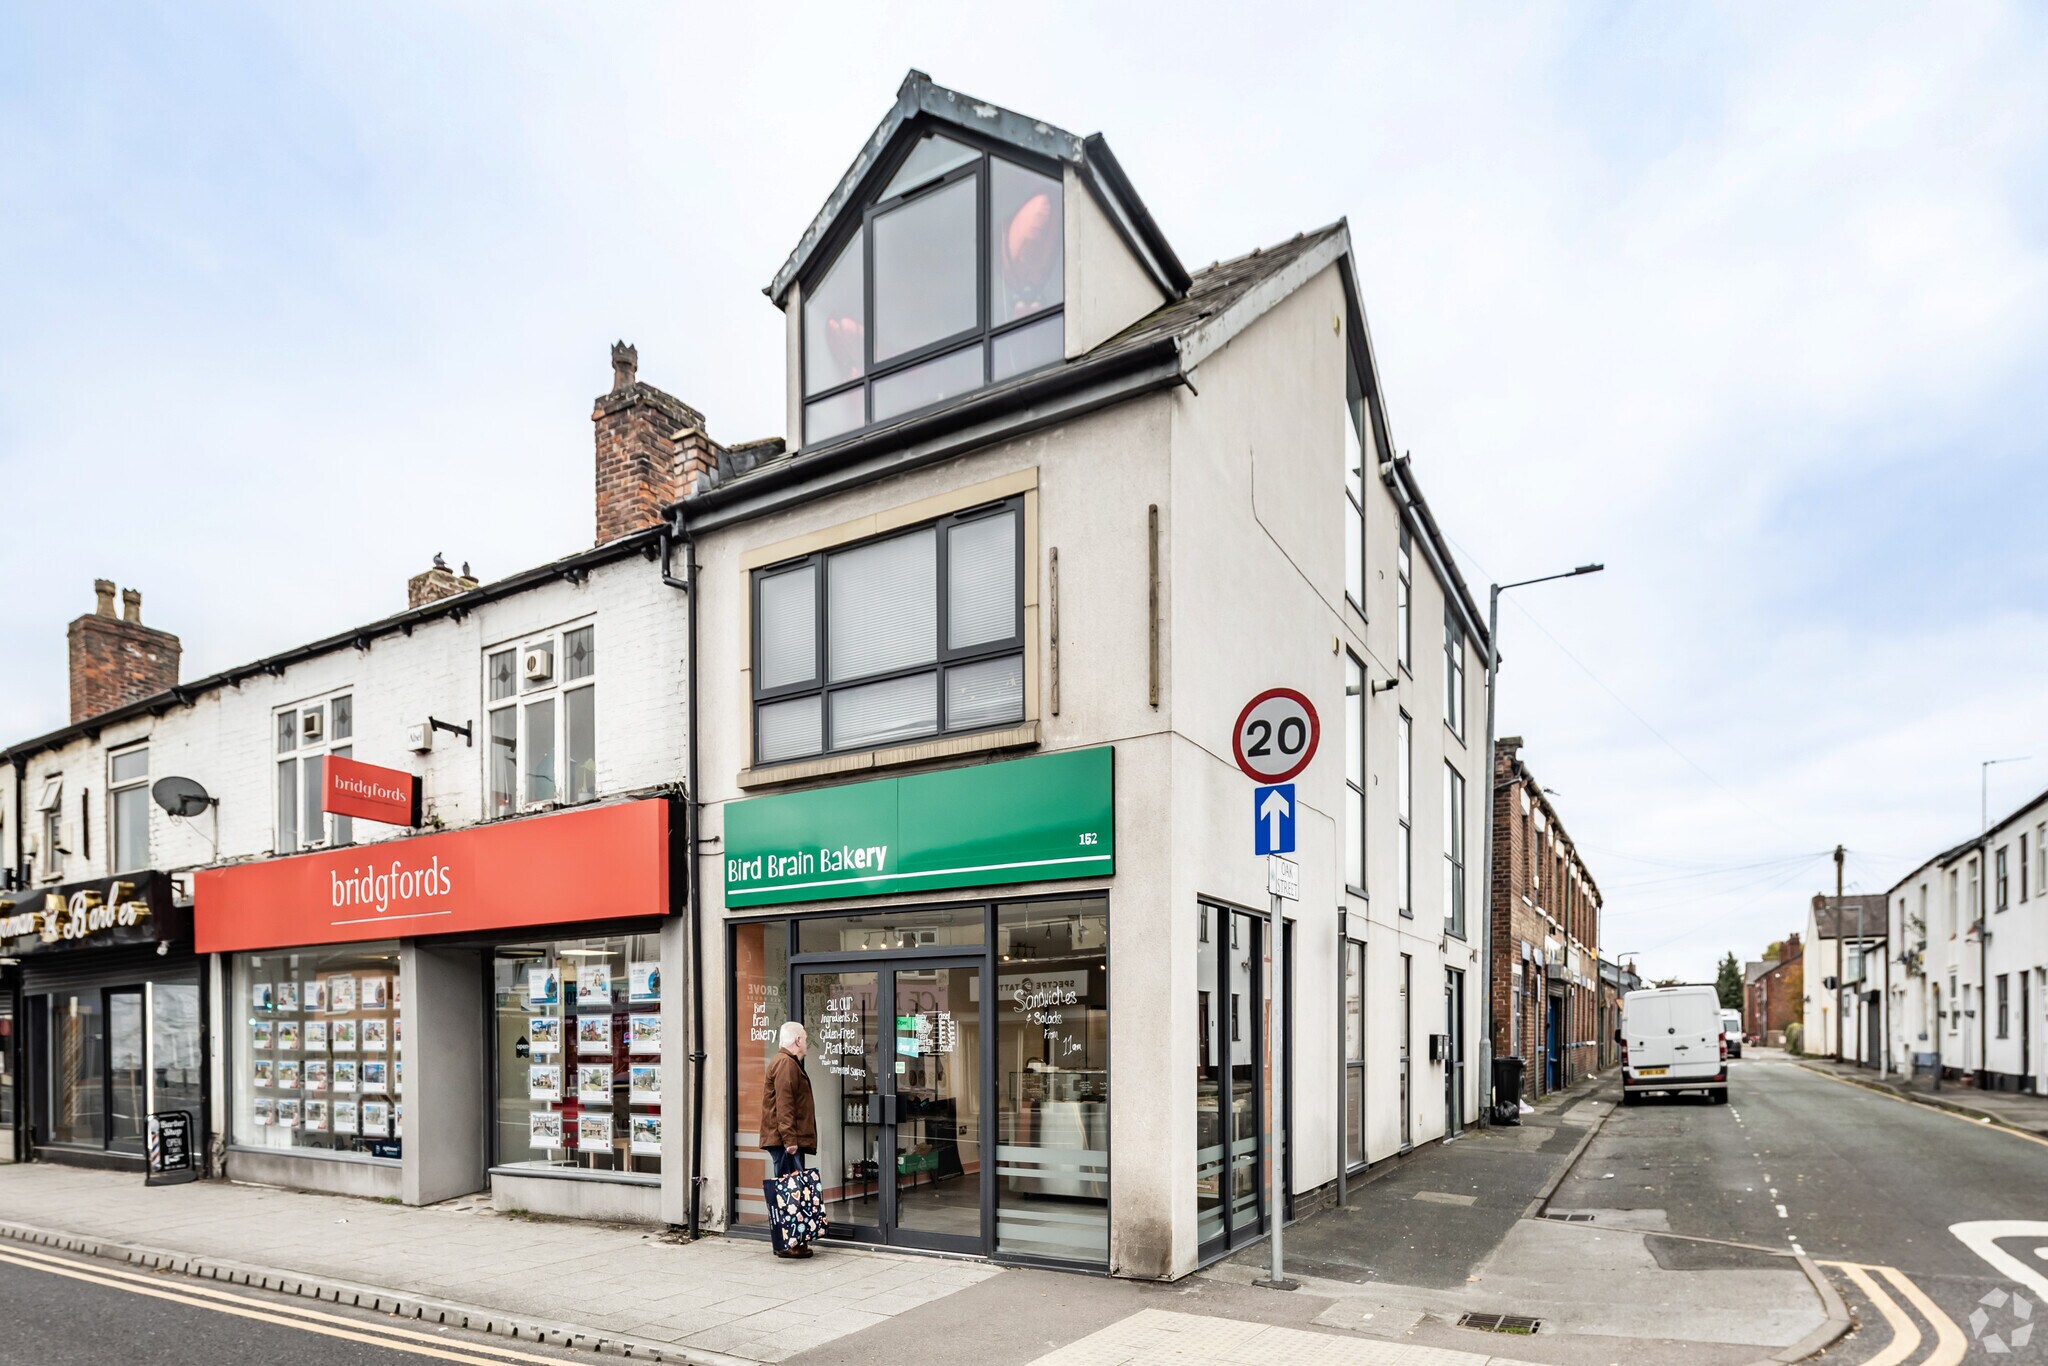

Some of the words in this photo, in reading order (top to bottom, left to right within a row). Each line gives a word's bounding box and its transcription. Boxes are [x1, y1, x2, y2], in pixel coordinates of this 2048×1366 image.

[1246, 716, 1306, 757] 20
[335, 774, 407, 802] bridgfords
[1079, 832, 1098, 845] 152
[728, 855, 762, 882] Bird
[767, 851, 814, 878] Brain
[820, 845, 887, 872] Bakery
[1281, 861, 1294, 879] OAK
[330, 855, 451, 912] bridgfords
[1277, 878, 1298, 897] STREET
[754, 1002, 766, 1013] Bird
[1013, 985, 1077, 1012] Sandwiches
[752, 1013, 769, 1026] Brain
[1033, 1011, 1063, 1025] Salads
[751, 1028, 777, 1043] Bakery
